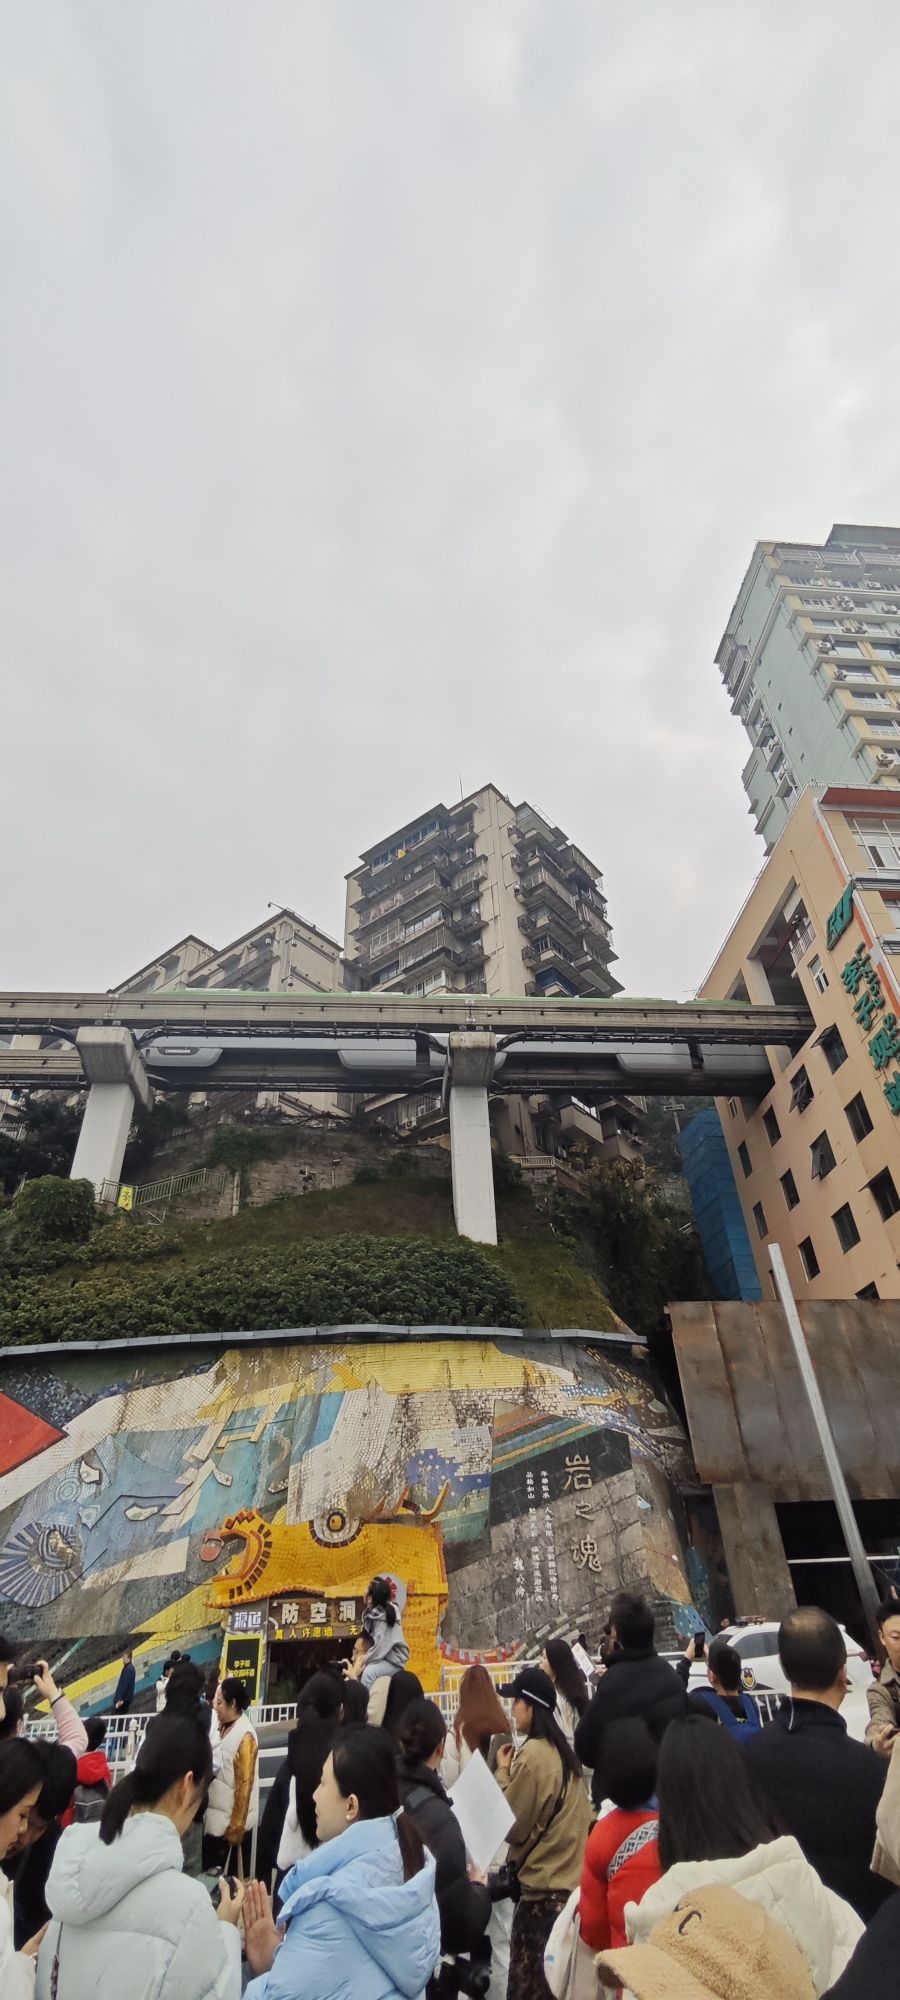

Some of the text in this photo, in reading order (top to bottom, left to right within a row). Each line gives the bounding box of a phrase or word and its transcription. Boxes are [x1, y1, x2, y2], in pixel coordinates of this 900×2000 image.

[526, 1471, 535, 1499] 品格如山
[564, 1454, 602, 1572] 岩之魂
[281, 1600, 356, 1625] 防空洞
